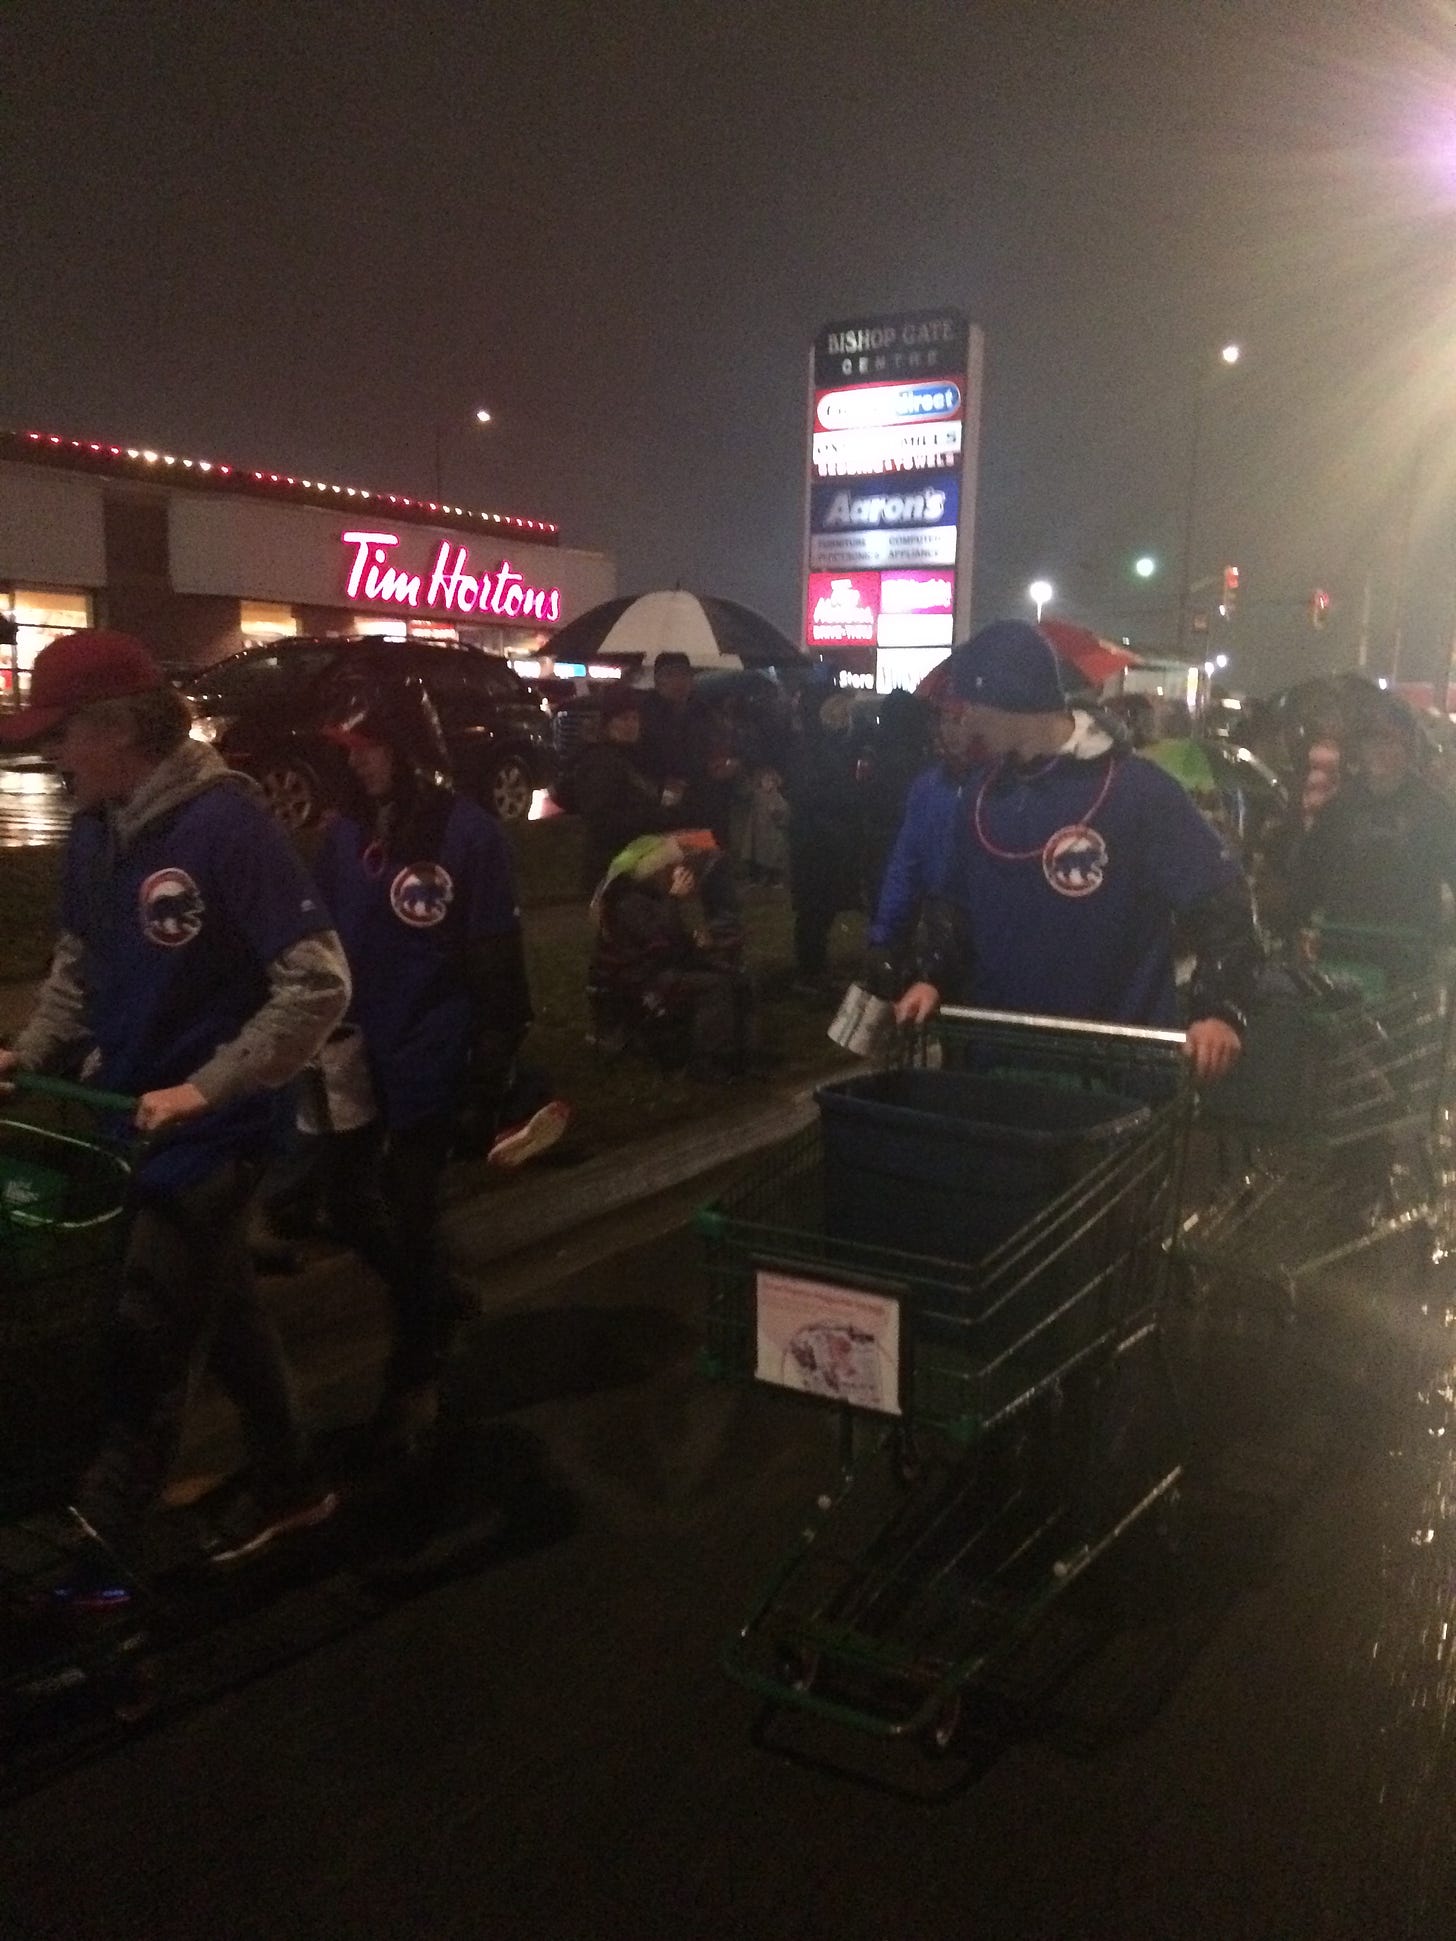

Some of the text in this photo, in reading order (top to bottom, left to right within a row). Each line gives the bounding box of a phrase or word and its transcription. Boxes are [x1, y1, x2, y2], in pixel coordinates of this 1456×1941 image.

[828, 320, 952, 354] BISHOP GATE
[827, 487, 945, 526] Aaron's
[343, 532, 560, 621] Tim Hortons
[839, 669, 875, 689] Store
